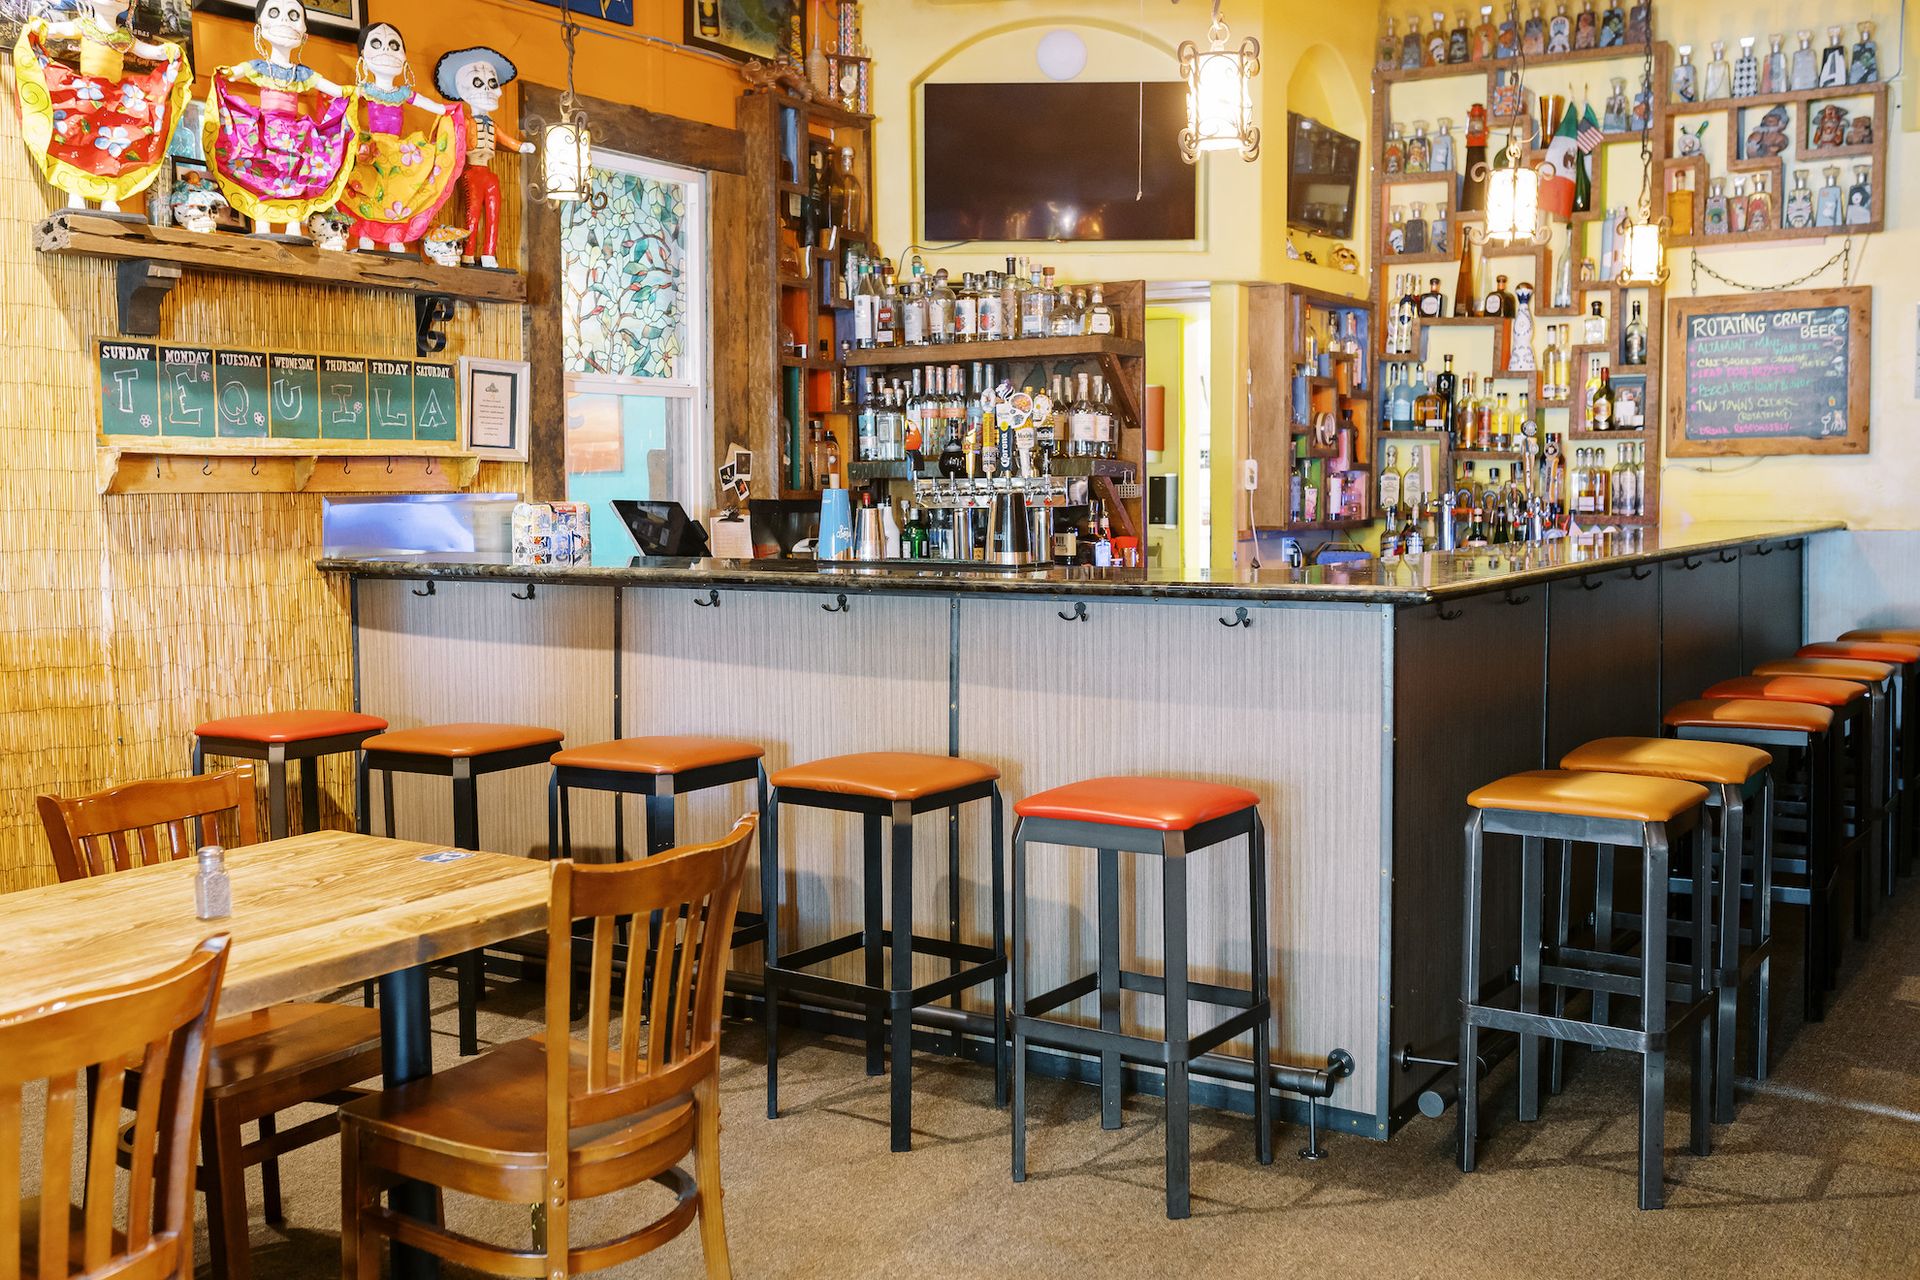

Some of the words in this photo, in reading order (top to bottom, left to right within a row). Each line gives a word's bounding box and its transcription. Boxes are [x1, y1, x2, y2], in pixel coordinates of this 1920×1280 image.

[1773, 311, 1816, 327] CRAFT
[1800, 324, 1838, 339] BEER
[102, 345, 150, 361] SUNDAY
[165, 350, 210, 364] MONDAY
[220, 353, 263, 367] TUESDAY
[274, 356, 315, 371] WEDNESDAY
[325, 359, 364, 373] THURSDAY
[372, 362, 409, 376] FRIDAY
[415, 365, 450, 379] SATURDAY
[1696, 399, 1718, 413] TWO
[1721, 397, 1754, 412] TOWNS
[1001, 432, 1010, 468] Corona
